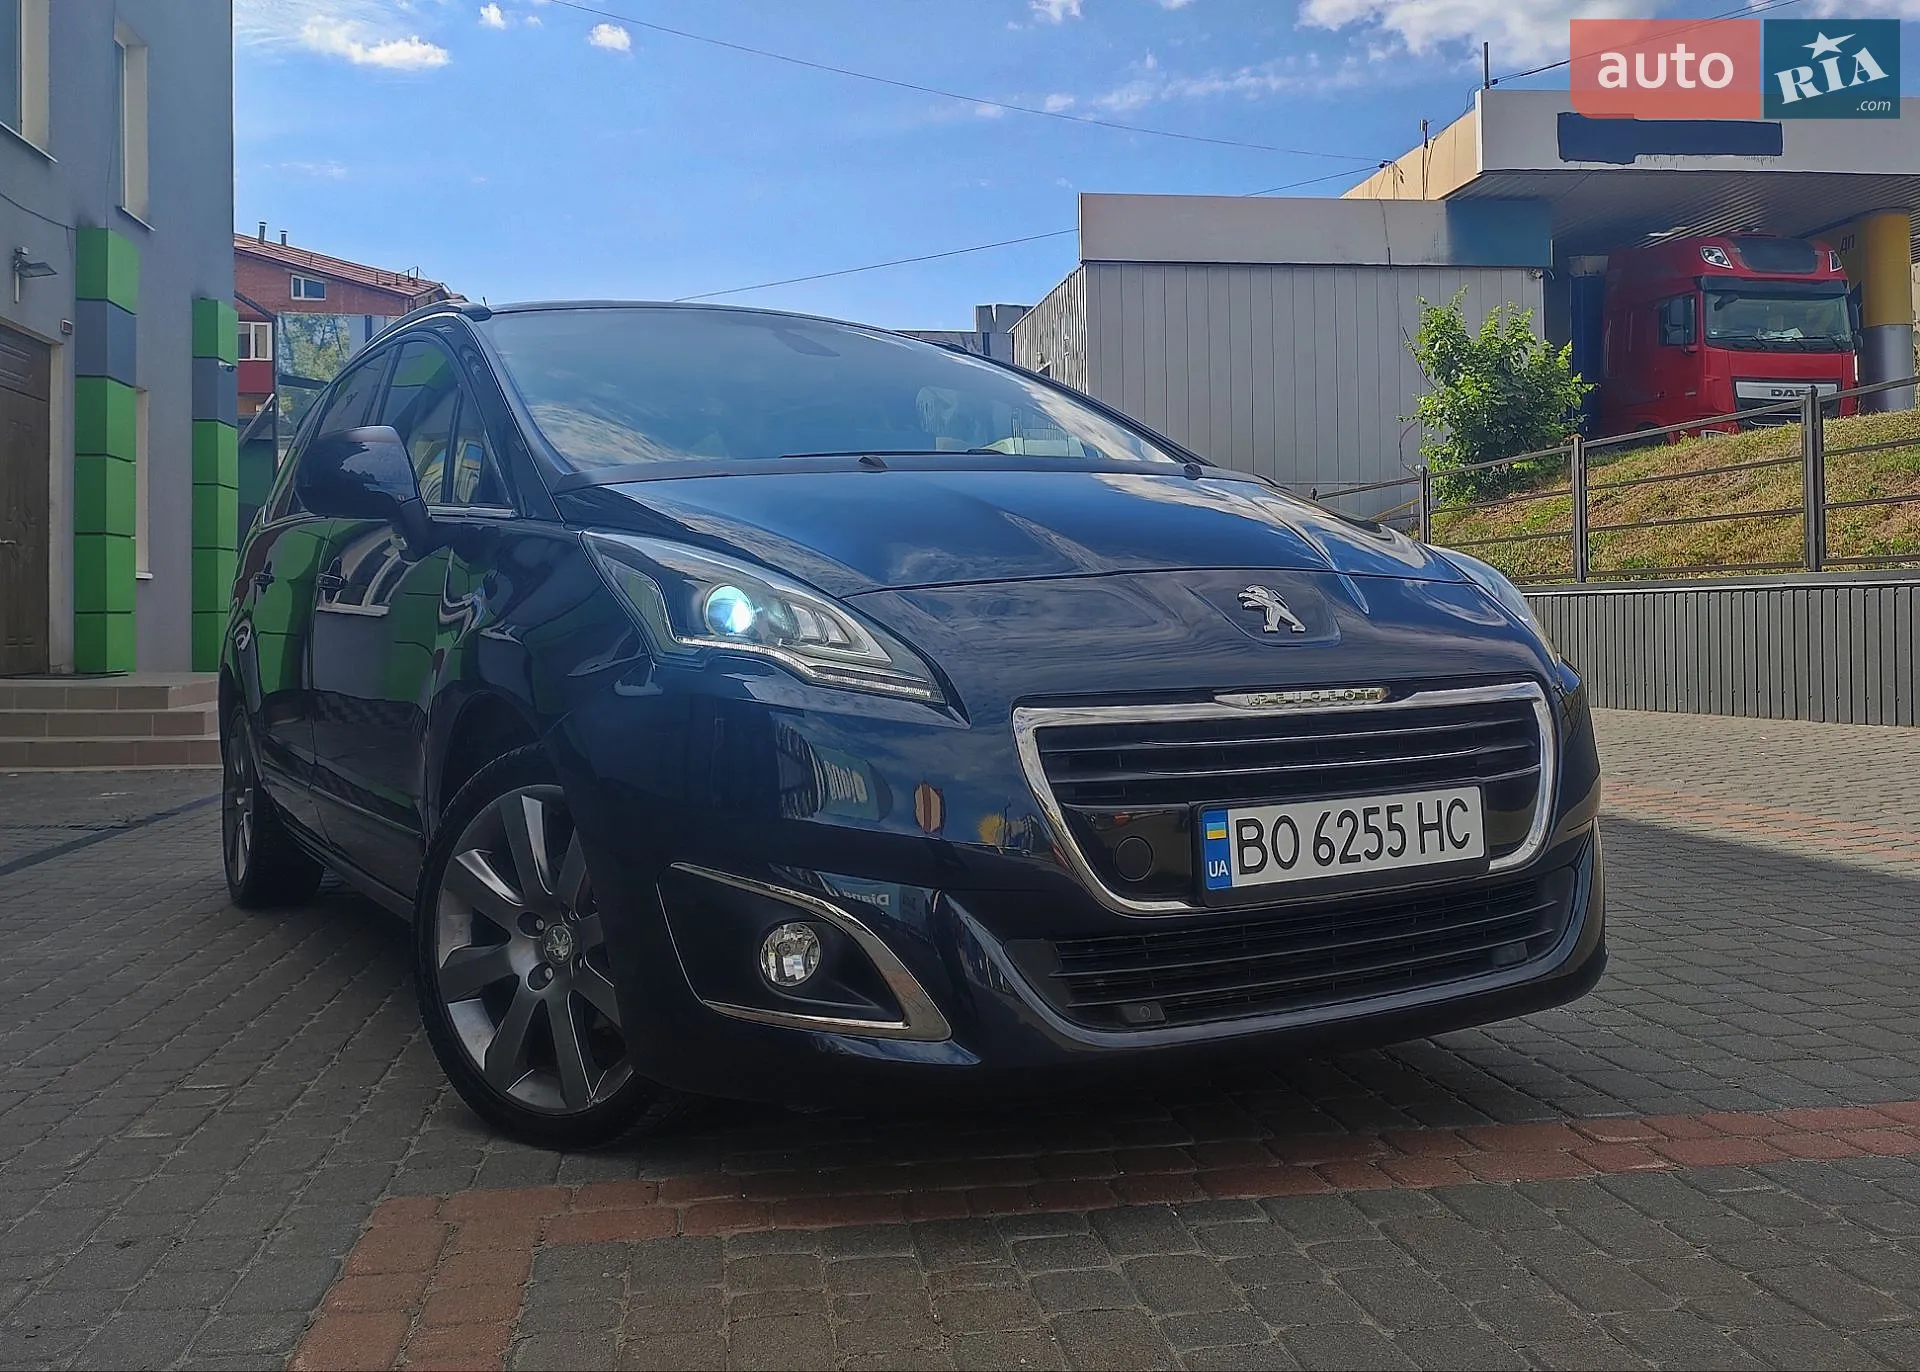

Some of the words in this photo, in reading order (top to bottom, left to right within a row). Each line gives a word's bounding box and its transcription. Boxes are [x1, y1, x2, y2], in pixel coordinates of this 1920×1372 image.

[1771, 388, 1808, 397] DAF
[1254, 689, 1373, 706] PEUGEOT
[1235, 815, 1300, 875] BO
[1312, 804, 1407, 867] 6255
[1417, 797, 1471, 855] HC
[1208, 860, 1229, 878] UA
